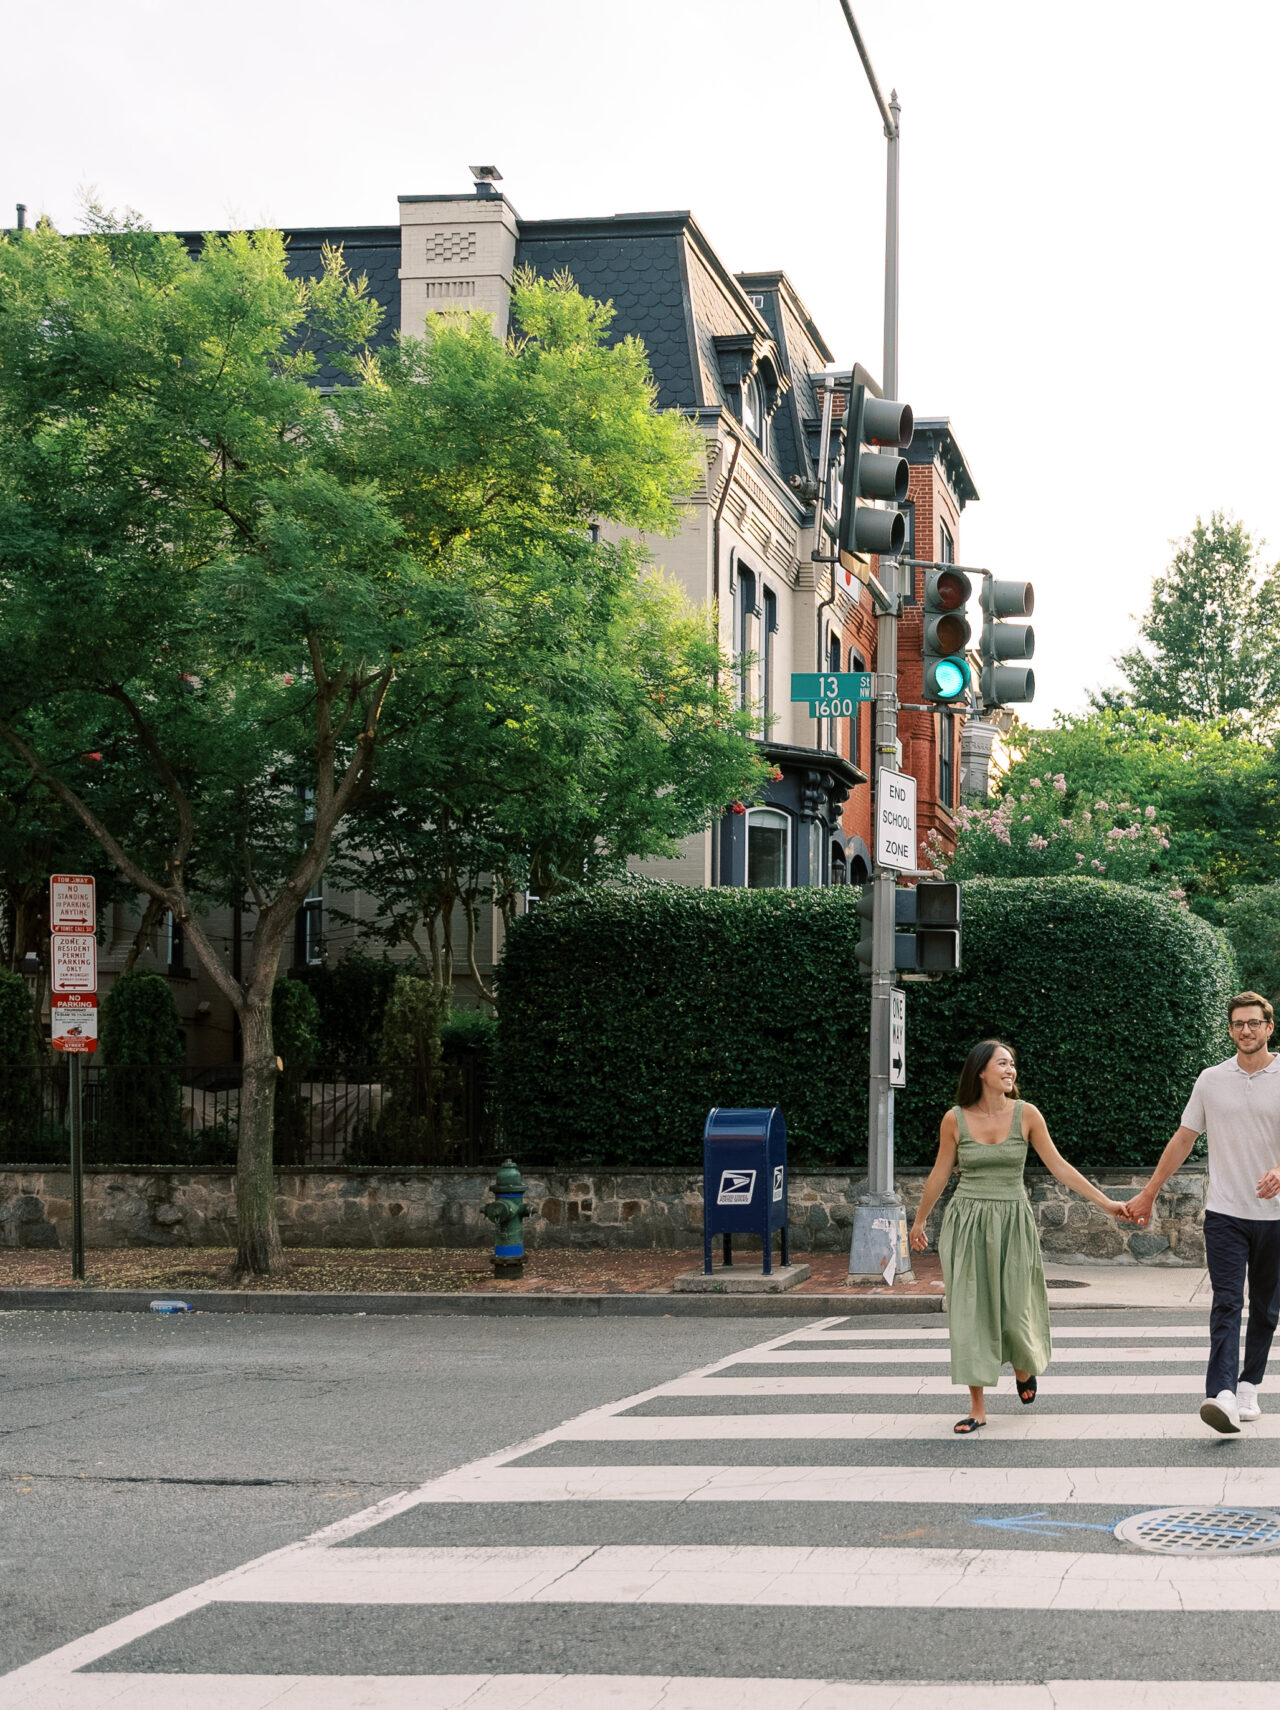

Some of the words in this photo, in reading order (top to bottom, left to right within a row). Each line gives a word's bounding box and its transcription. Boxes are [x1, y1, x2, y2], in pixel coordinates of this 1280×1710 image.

[819, 676, 839, 698] 13
[860, 676, 870, 687] St
[860, 688, 870, 698] NW
[815, 699, 853, 717] 1600
[890, 785, 906, 802] END
[882, 809, 912, 831] SCHOOL
[886, 840, 909, 858] ZONE
[893, 997, 903, 1020] ONE
[893, 1023, 903, 1045] WAY
